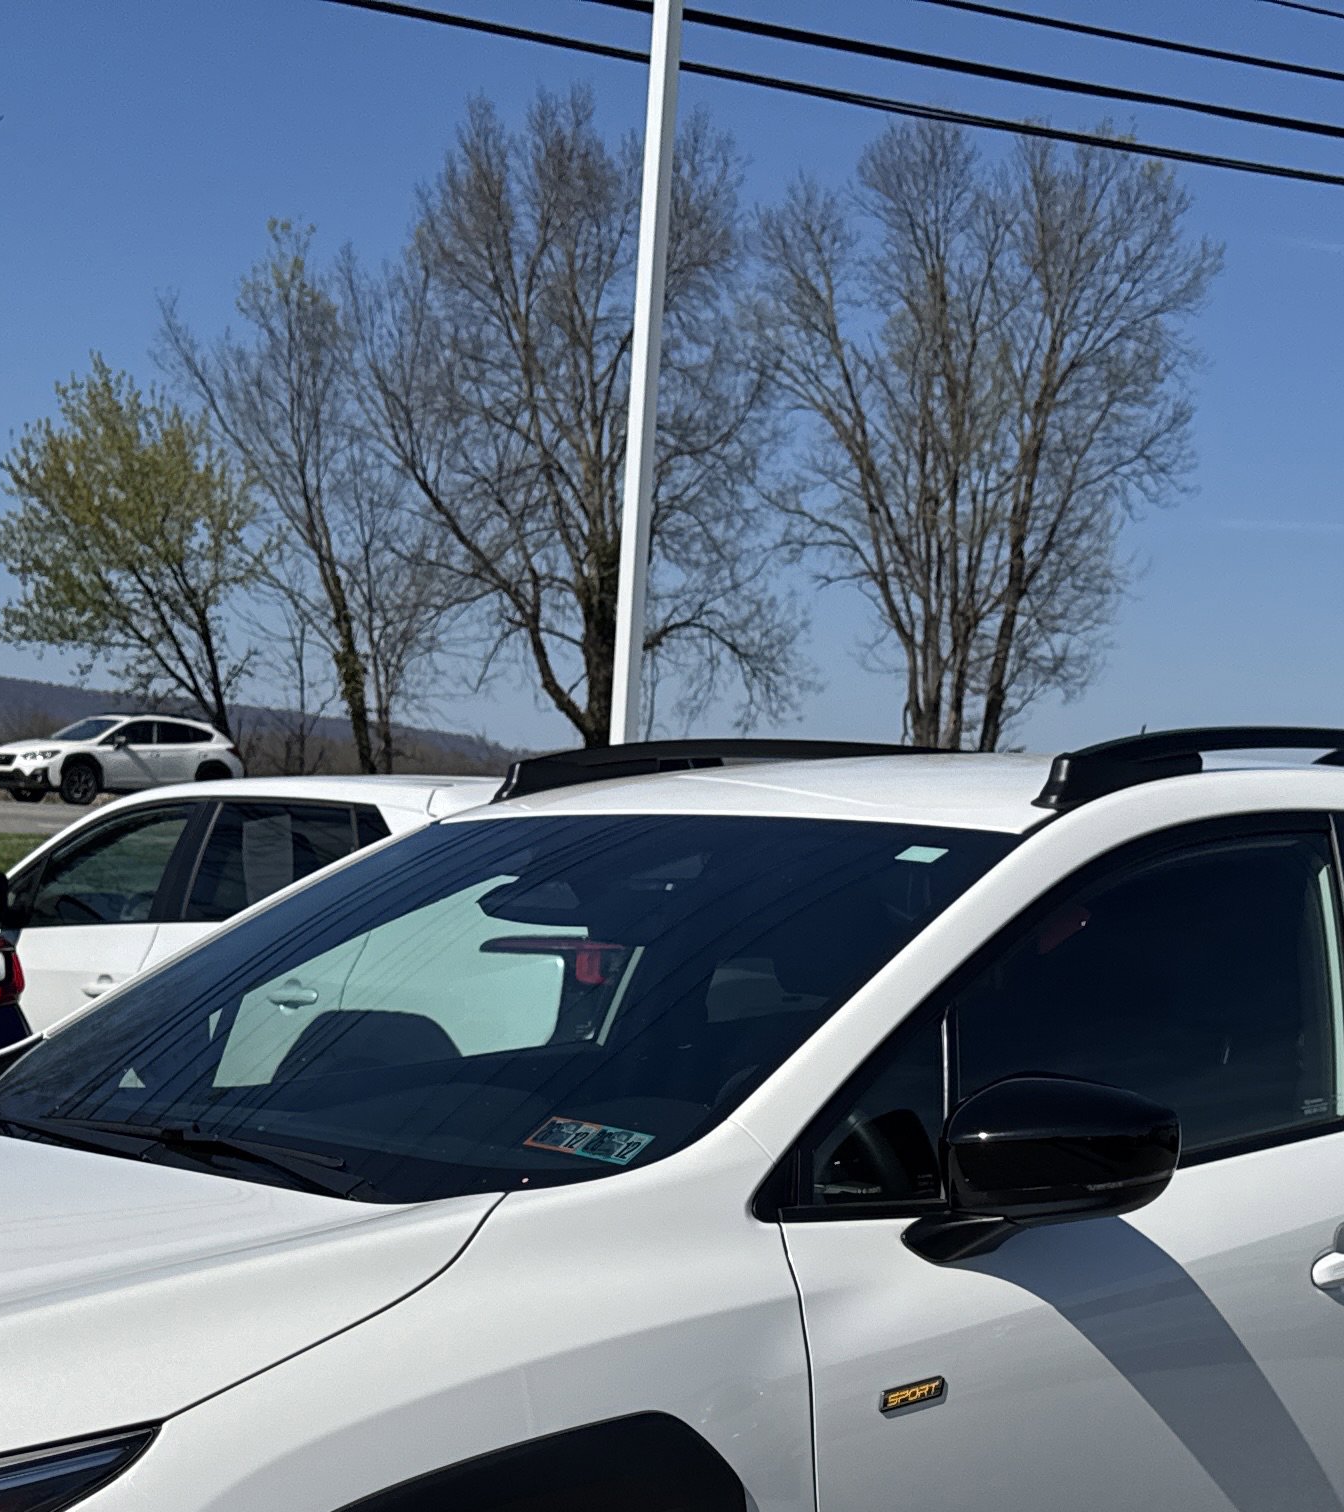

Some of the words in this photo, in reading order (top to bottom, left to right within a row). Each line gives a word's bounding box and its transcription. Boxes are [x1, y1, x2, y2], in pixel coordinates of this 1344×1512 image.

[563, 1131, 589, 1149] 12
[614, 1140, 642, 1159] 12
[886, 1380, 940, 1408] SPORT
